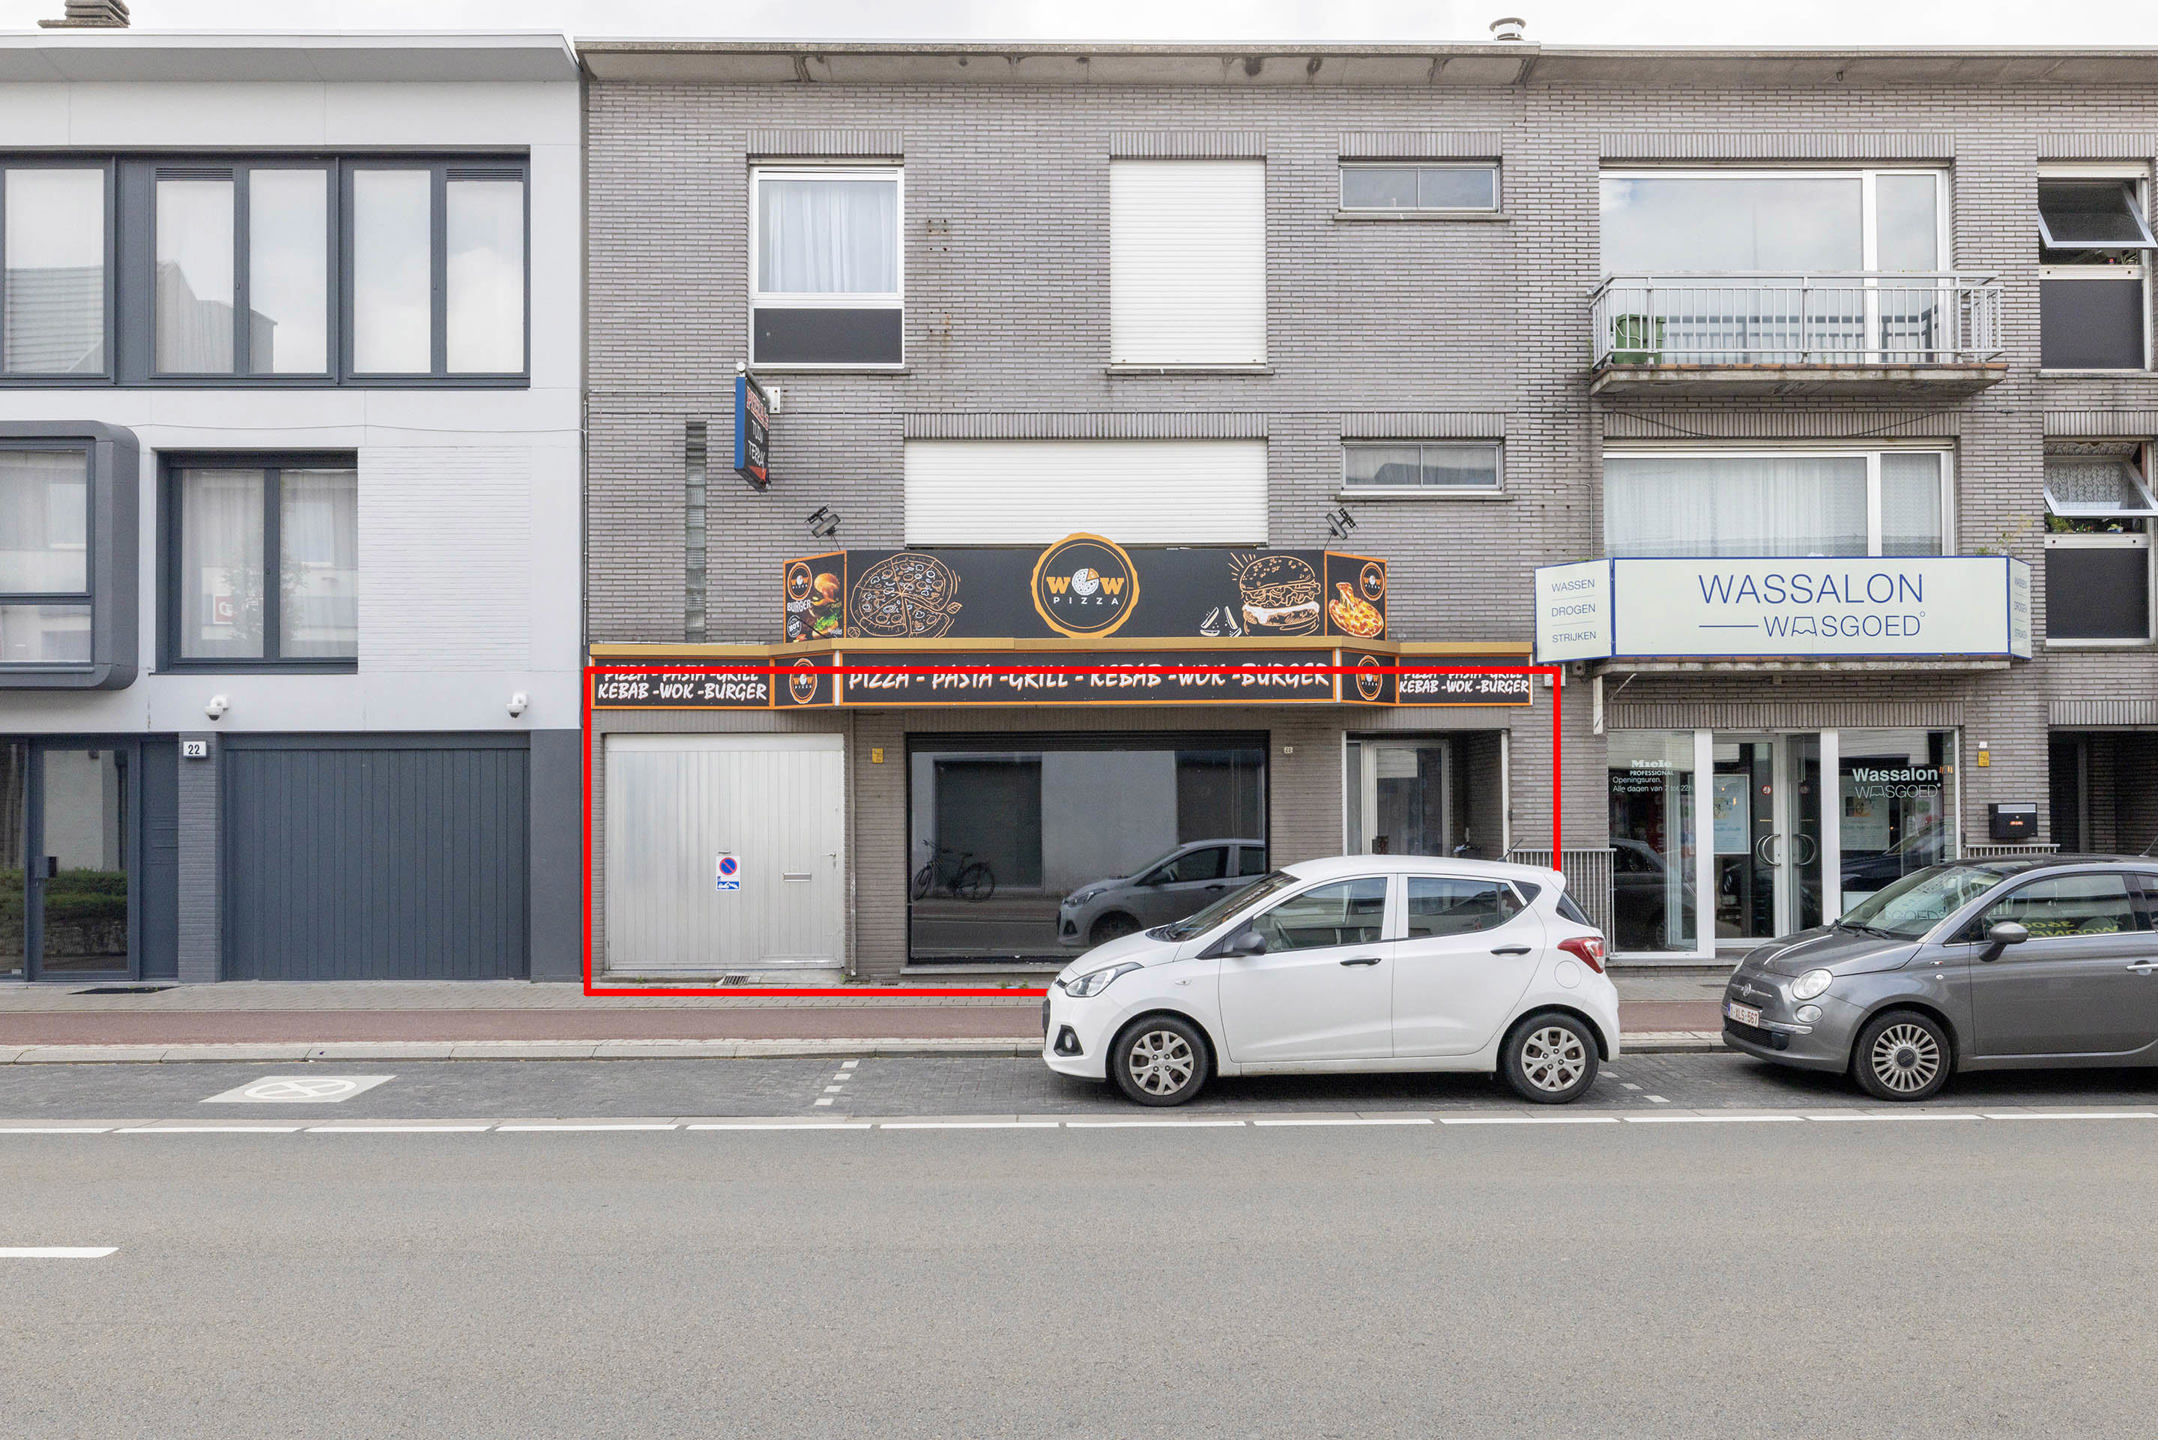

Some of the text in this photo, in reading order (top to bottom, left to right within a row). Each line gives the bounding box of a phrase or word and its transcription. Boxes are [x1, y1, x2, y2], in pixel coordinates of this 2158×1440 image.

[1551, 579, 1595, 593] WASSEN
[1698, 573, 1923, 604] WASSALON
[1053, 597, 1119, 605] PIZZA
[1551, 604, 1596, 617] DROGEN
[1552, 632, 1597, 643] STRIJKEN
[598, 682, 649, 699] KEBAB
[1399, 679, 1439, 693] KEBAB
[188, 744, 200, 755] 22
[1631, 760, 1672, 768] Miele
[1853, 767, 1938, 782] Wassalon
[1627, 785, 1649, 793] dagen
